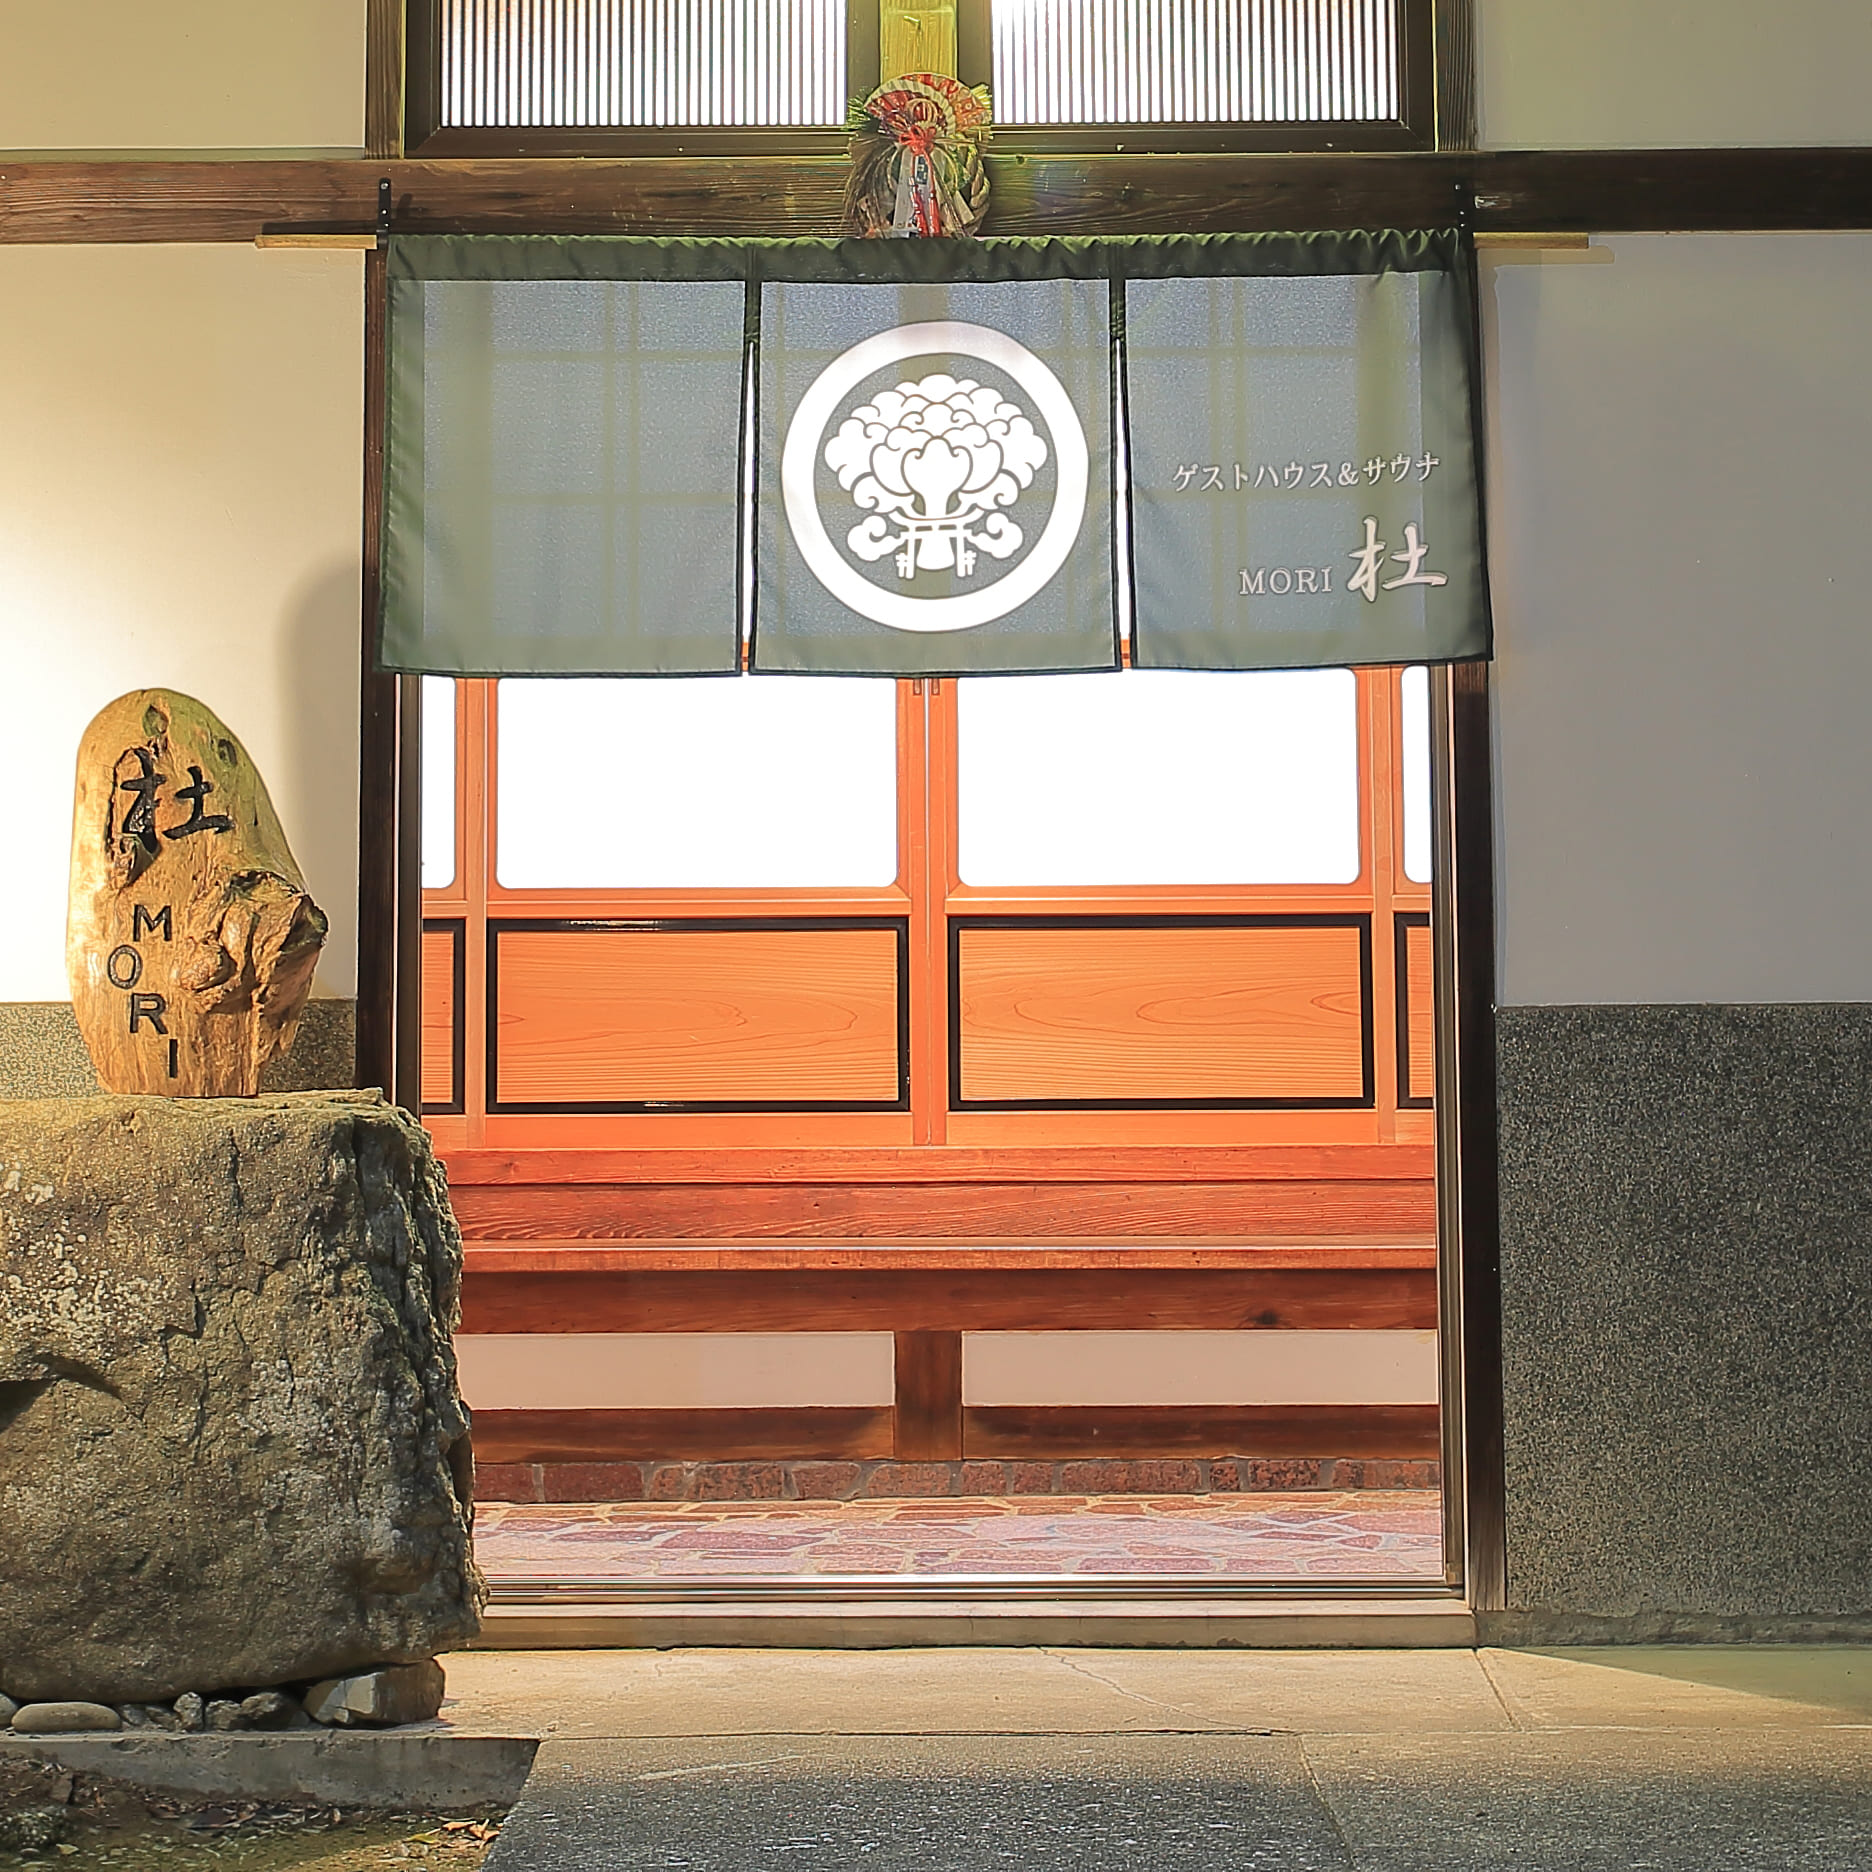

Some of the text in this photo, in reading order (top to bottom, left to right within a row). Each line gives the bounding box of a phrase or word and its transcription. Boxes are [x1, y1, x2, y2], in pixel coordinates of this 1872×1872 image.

[1172, 451, 1440, 492] ゲストハウス&サウナ
[1239, 516, 1448, 603] MORI 杜
[120, 747, 236, 854] 杜
[107, 904, 179, 1079] MORI
